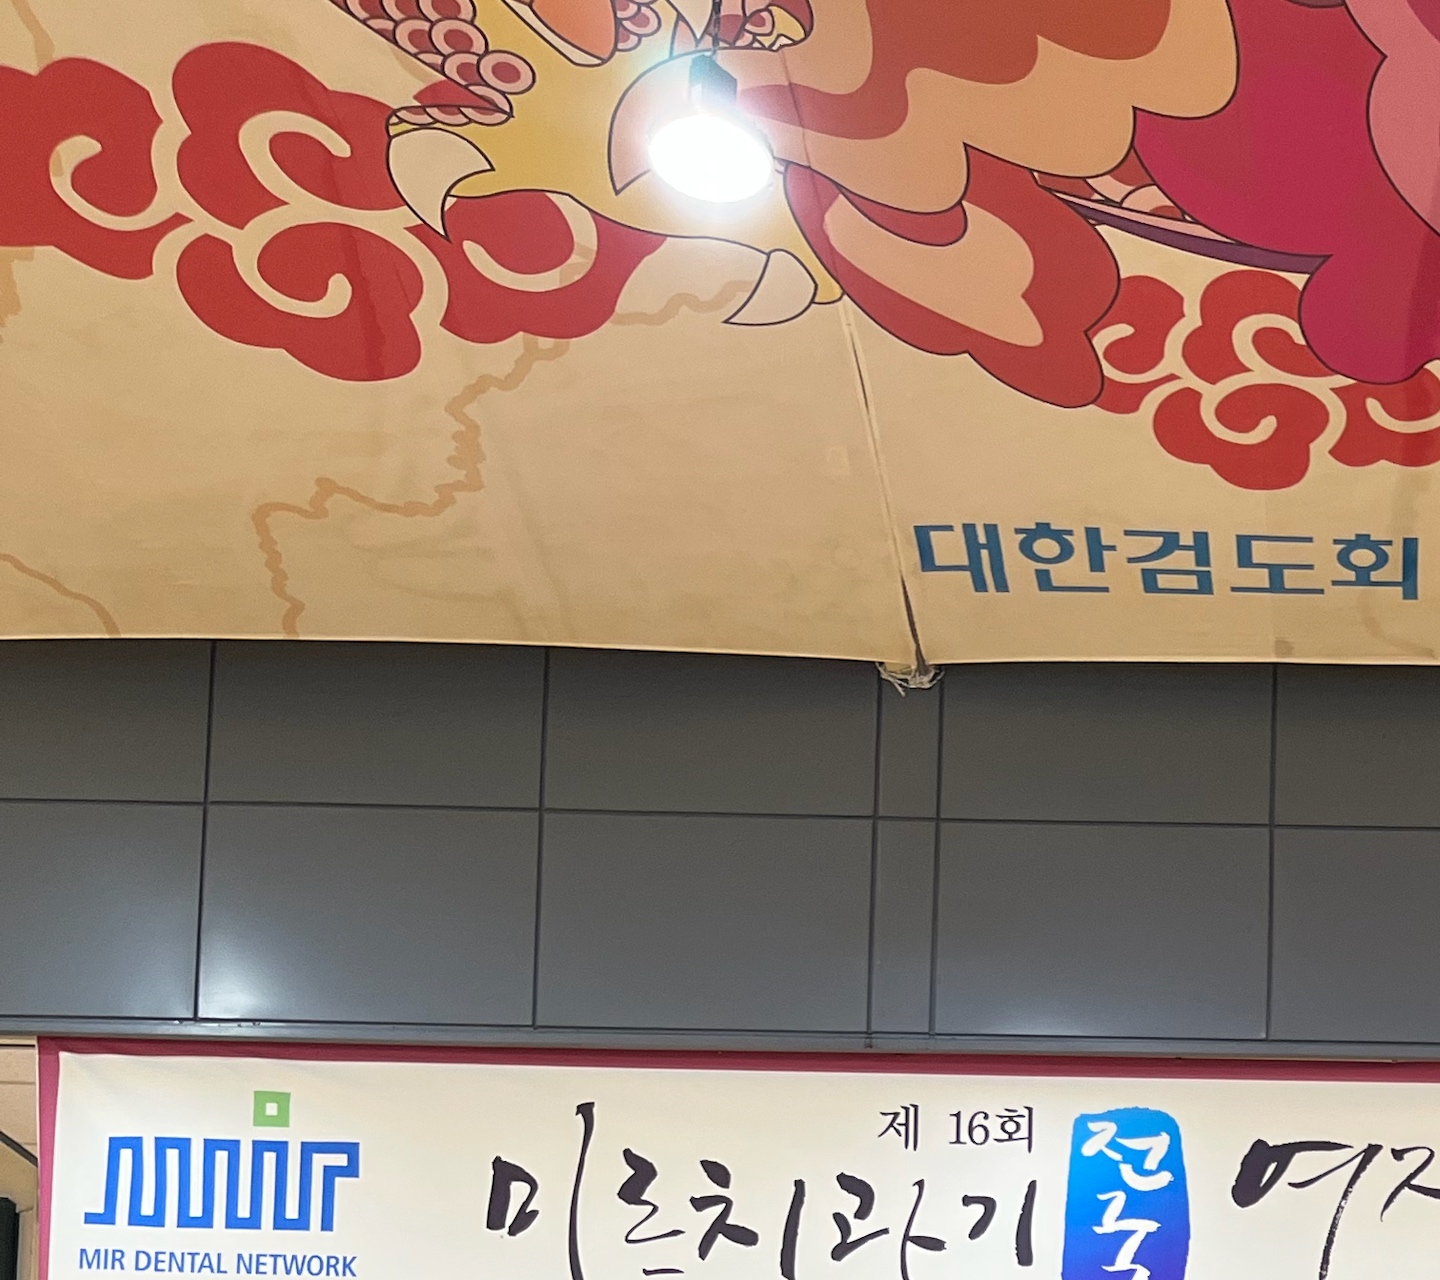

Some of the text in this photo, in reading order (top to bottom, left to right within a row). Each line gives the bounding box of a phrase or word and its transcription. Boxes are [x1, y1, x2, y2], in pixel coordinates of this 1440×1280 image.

[912, 522, 1419, 601] 대한검도회
[877, 1103, 1034, 1153] 제 16회
[79, 1248, 358, 1278] MIR DENTAL NETWORK
